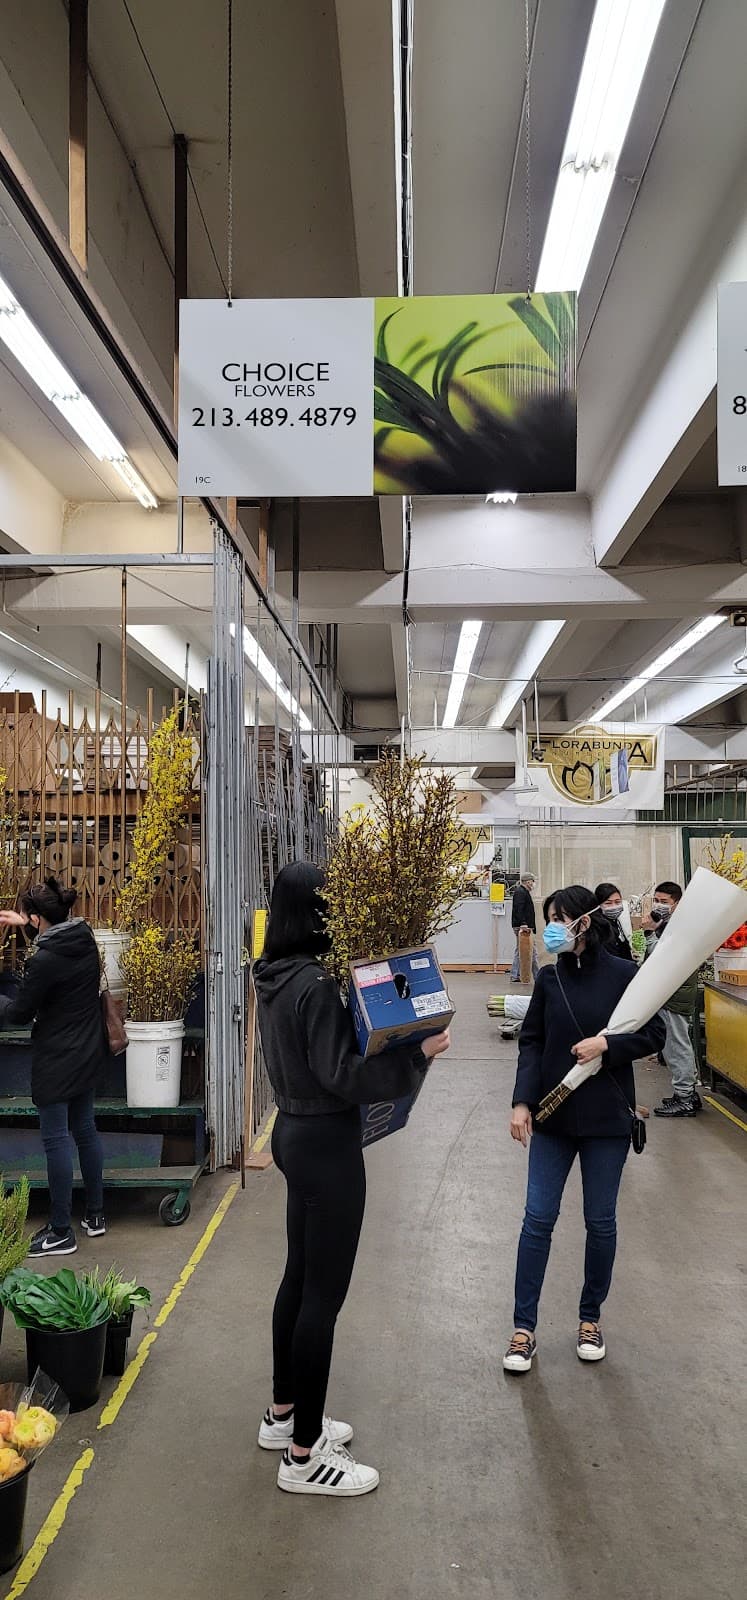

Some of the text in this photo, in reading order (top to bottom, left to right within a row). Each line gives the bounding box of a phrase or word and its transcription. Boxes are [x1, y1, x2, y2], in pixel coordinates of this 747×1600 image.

[221, 362, 330, 382] CHOICE
[234, 384, 316, 398] FLOWERS
[195, 476, 211, 484] 19C
